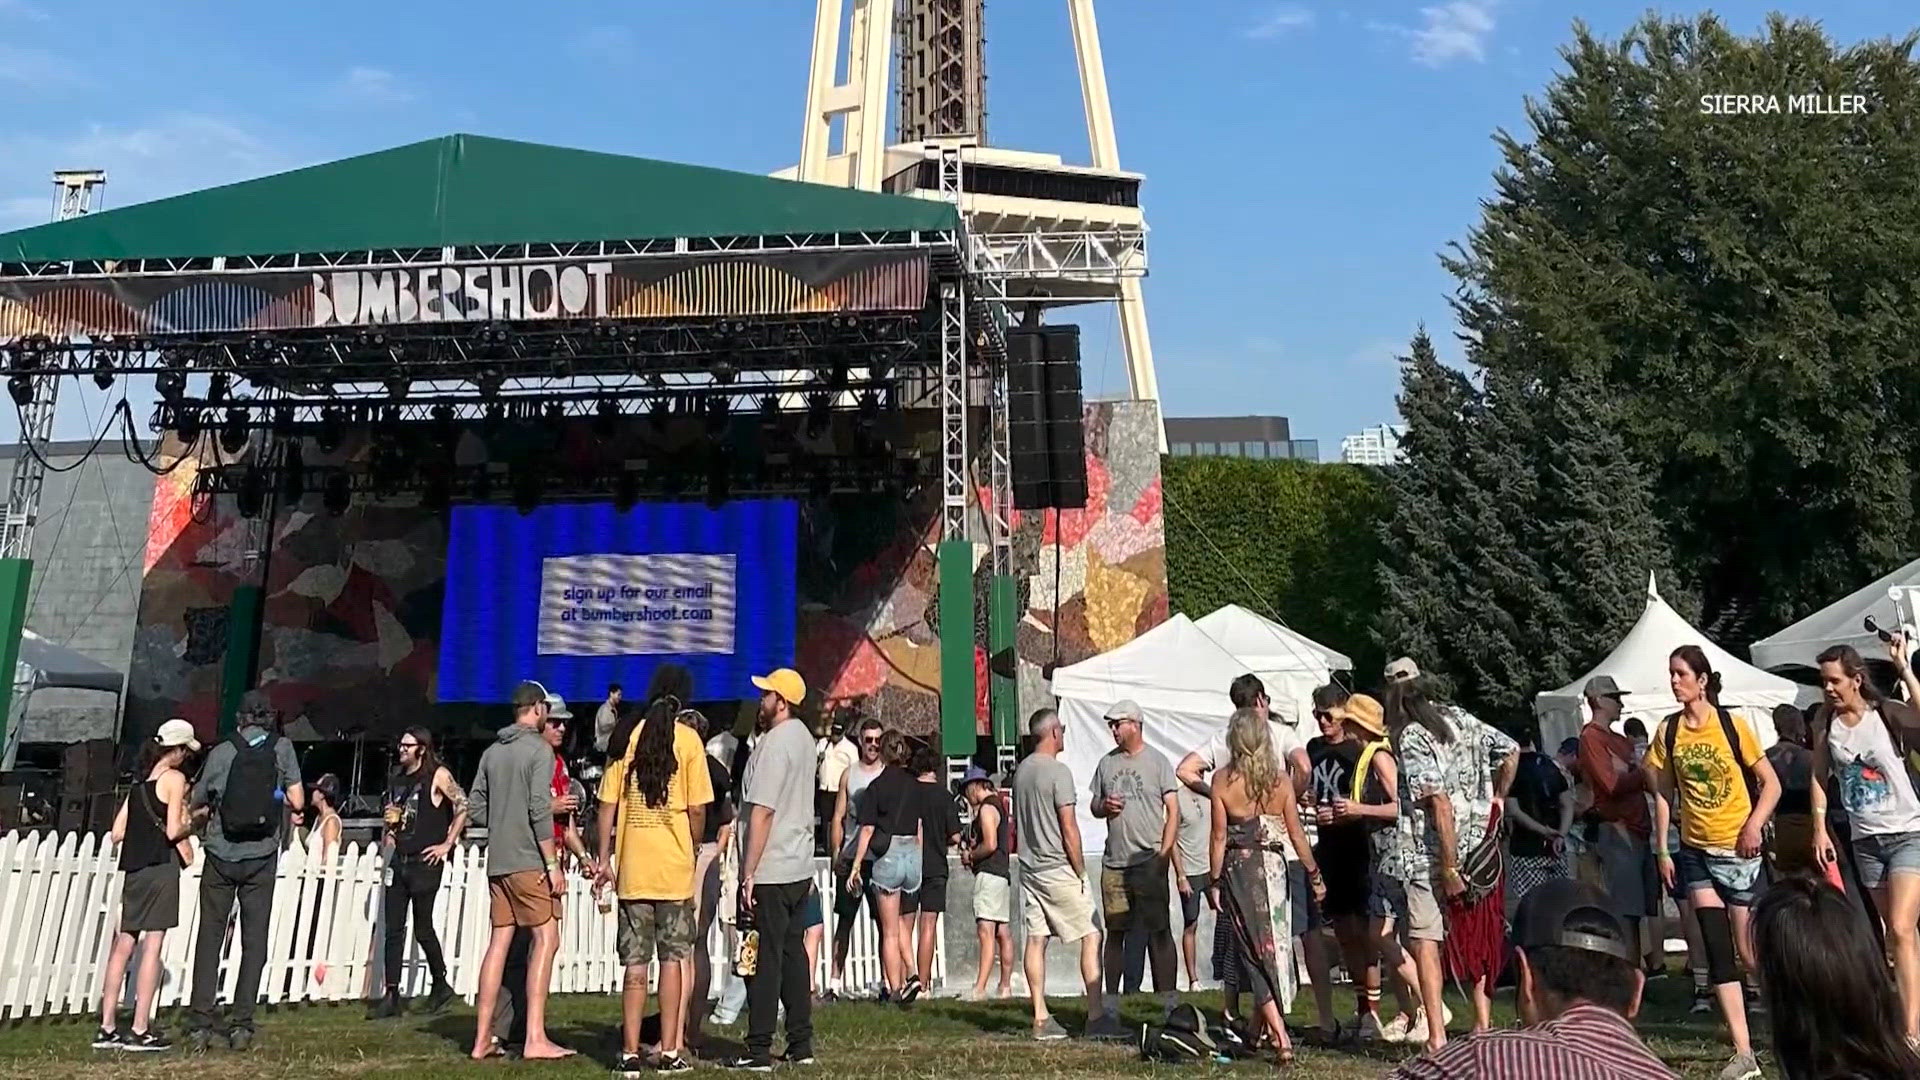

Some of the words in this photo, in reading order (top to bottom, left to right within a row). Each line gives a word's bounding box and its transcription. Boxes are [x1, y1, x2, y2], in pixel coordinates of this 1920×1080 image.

[312, 262, 612, 326] BUMBERSHOOT
[563, 586, 593, 604] sign
[597, 588, 615, 603] up
[620, 585, 641, 599] for
[645, 588, 667, 599] our
[673, 583, 713, 598] email
[561, 608, 576, 621] at
[581, 606, 713, 621] bumbershoot.com
